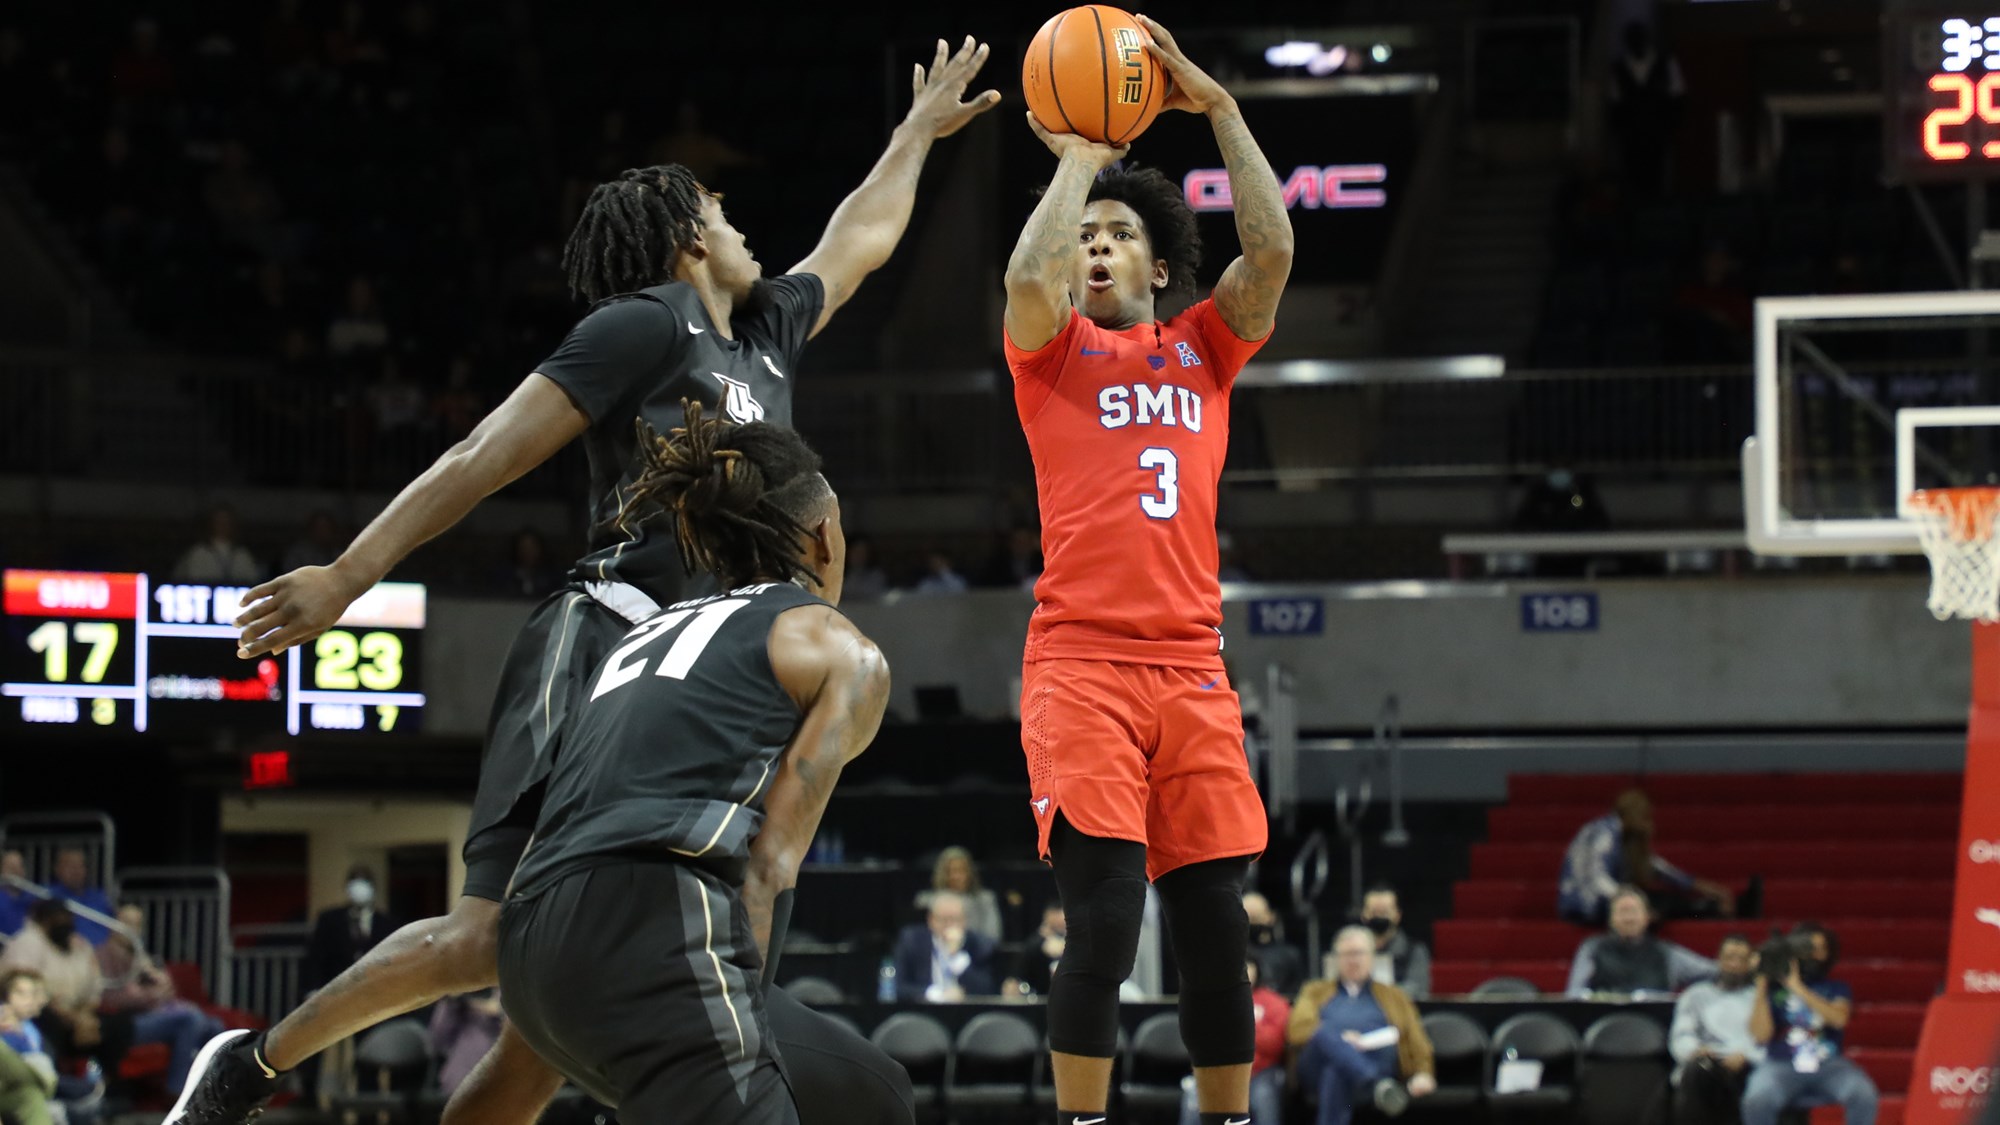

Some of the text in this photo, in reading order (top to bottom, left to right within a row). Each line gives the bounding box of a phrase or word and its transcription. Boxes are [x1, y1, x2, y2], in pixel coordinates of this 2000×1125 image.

[1117, 27, 1143, 105] ELITE
[1098, 383, 1202, 434] SMU
[1139, 446, 1179, 520] 3
[1259, 601, 1315, 632] 107
[1532, 598, 1589, 628] 108
[27, 621, 119, 683] 17
[315, 631, 403, 690] 23
[590, 599, 751, 702] 21
